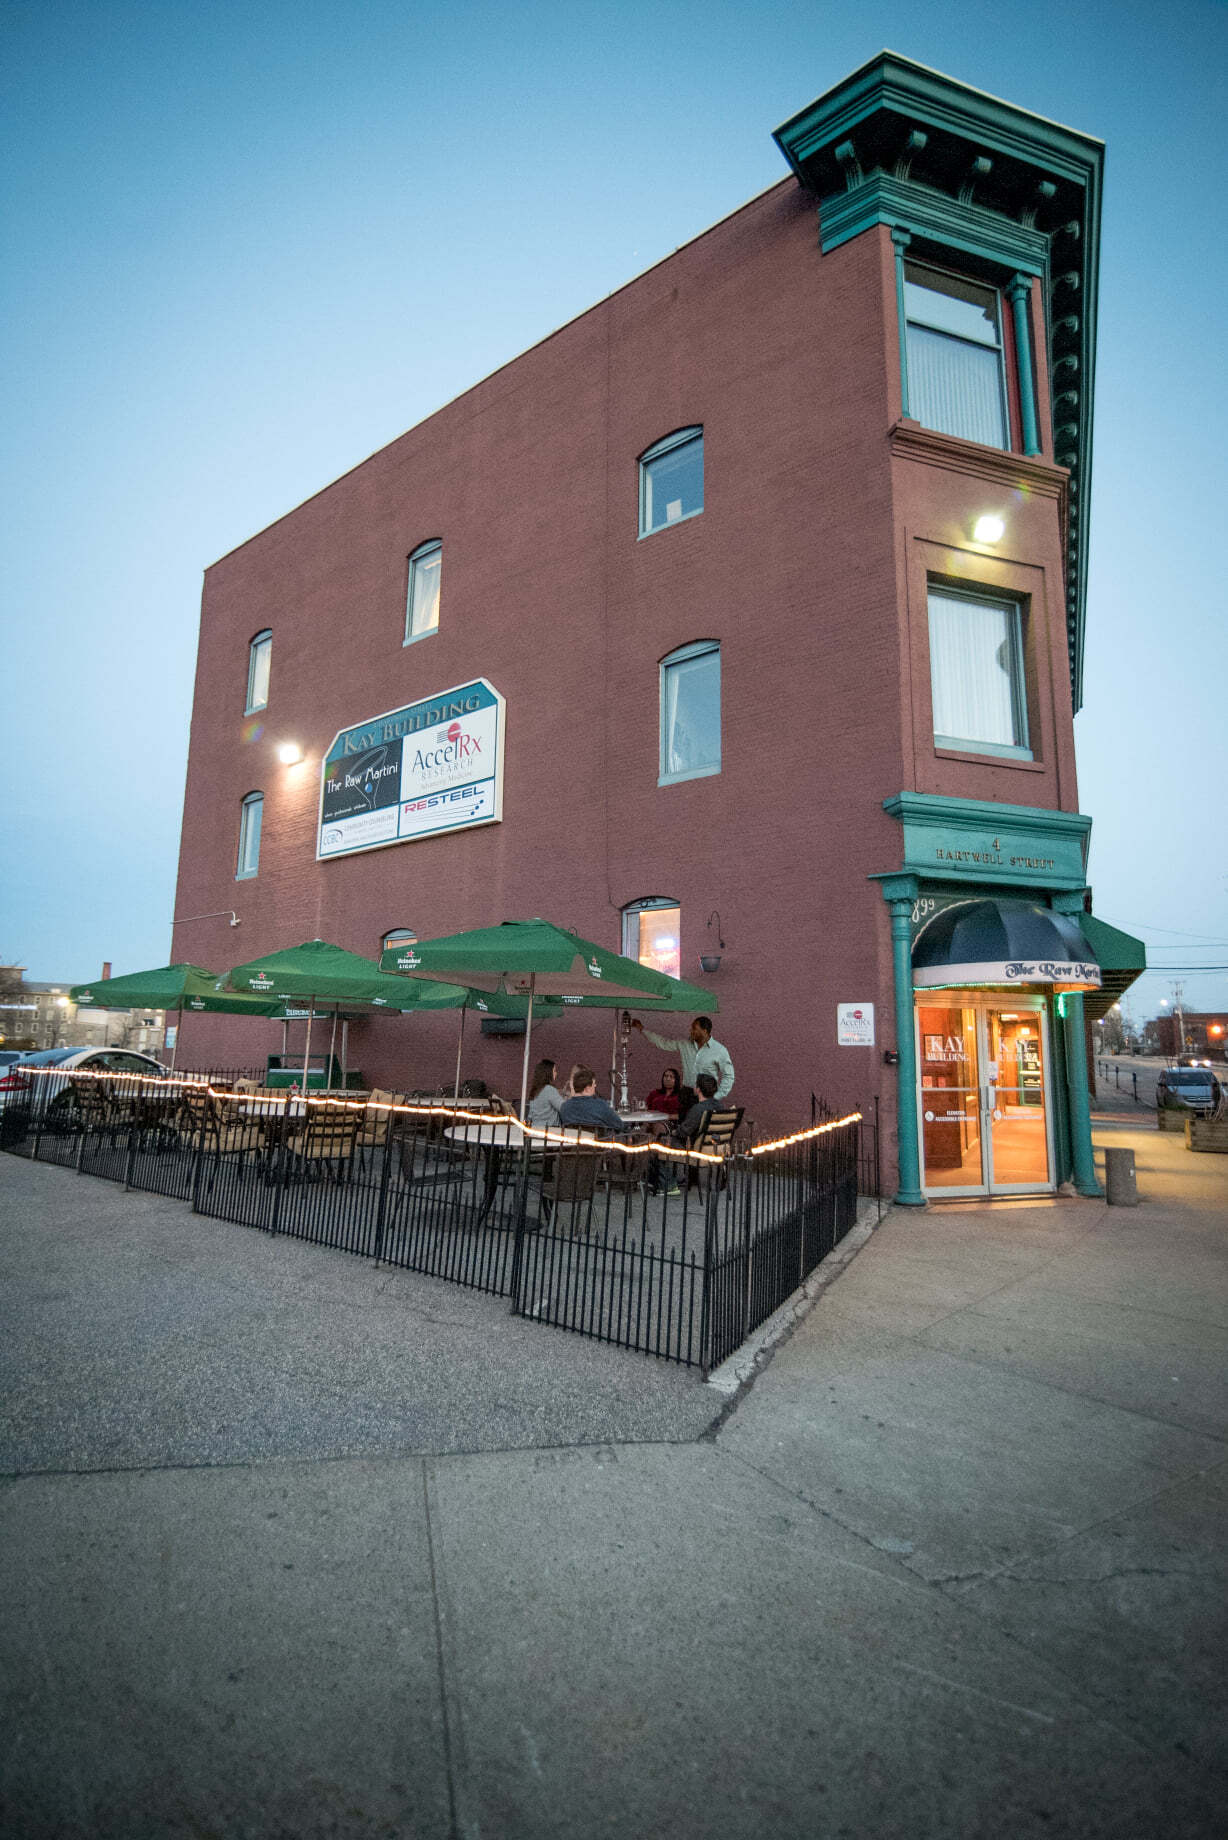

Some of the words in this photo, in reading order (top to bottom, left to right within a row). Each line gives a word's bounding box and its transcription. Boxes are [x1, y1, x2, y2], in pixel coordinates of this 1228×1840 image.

[343, 731, 376, 755] KAY
[383, 695, 481, 740] BUILDING
[412, 734, 483, 774] AccelRx
[327, 779, 342, 794] The
[345, 774, 362, 788] Raw
[365, 761, 399, 783] Martini
[404, 786, 485, 814] RESTEEL
[991, 837, 1001, 851] 4
[935, 848, 1004, 865] HARTWELL
[1009, 856, 1056, 870] STREET
[1004, 962, 1035, 979] The
[1039, 962, 1073, 980] Raw
[930, 1036, 964, 1052] KAY
[927, 1052, 970, 1061] BUILDING
